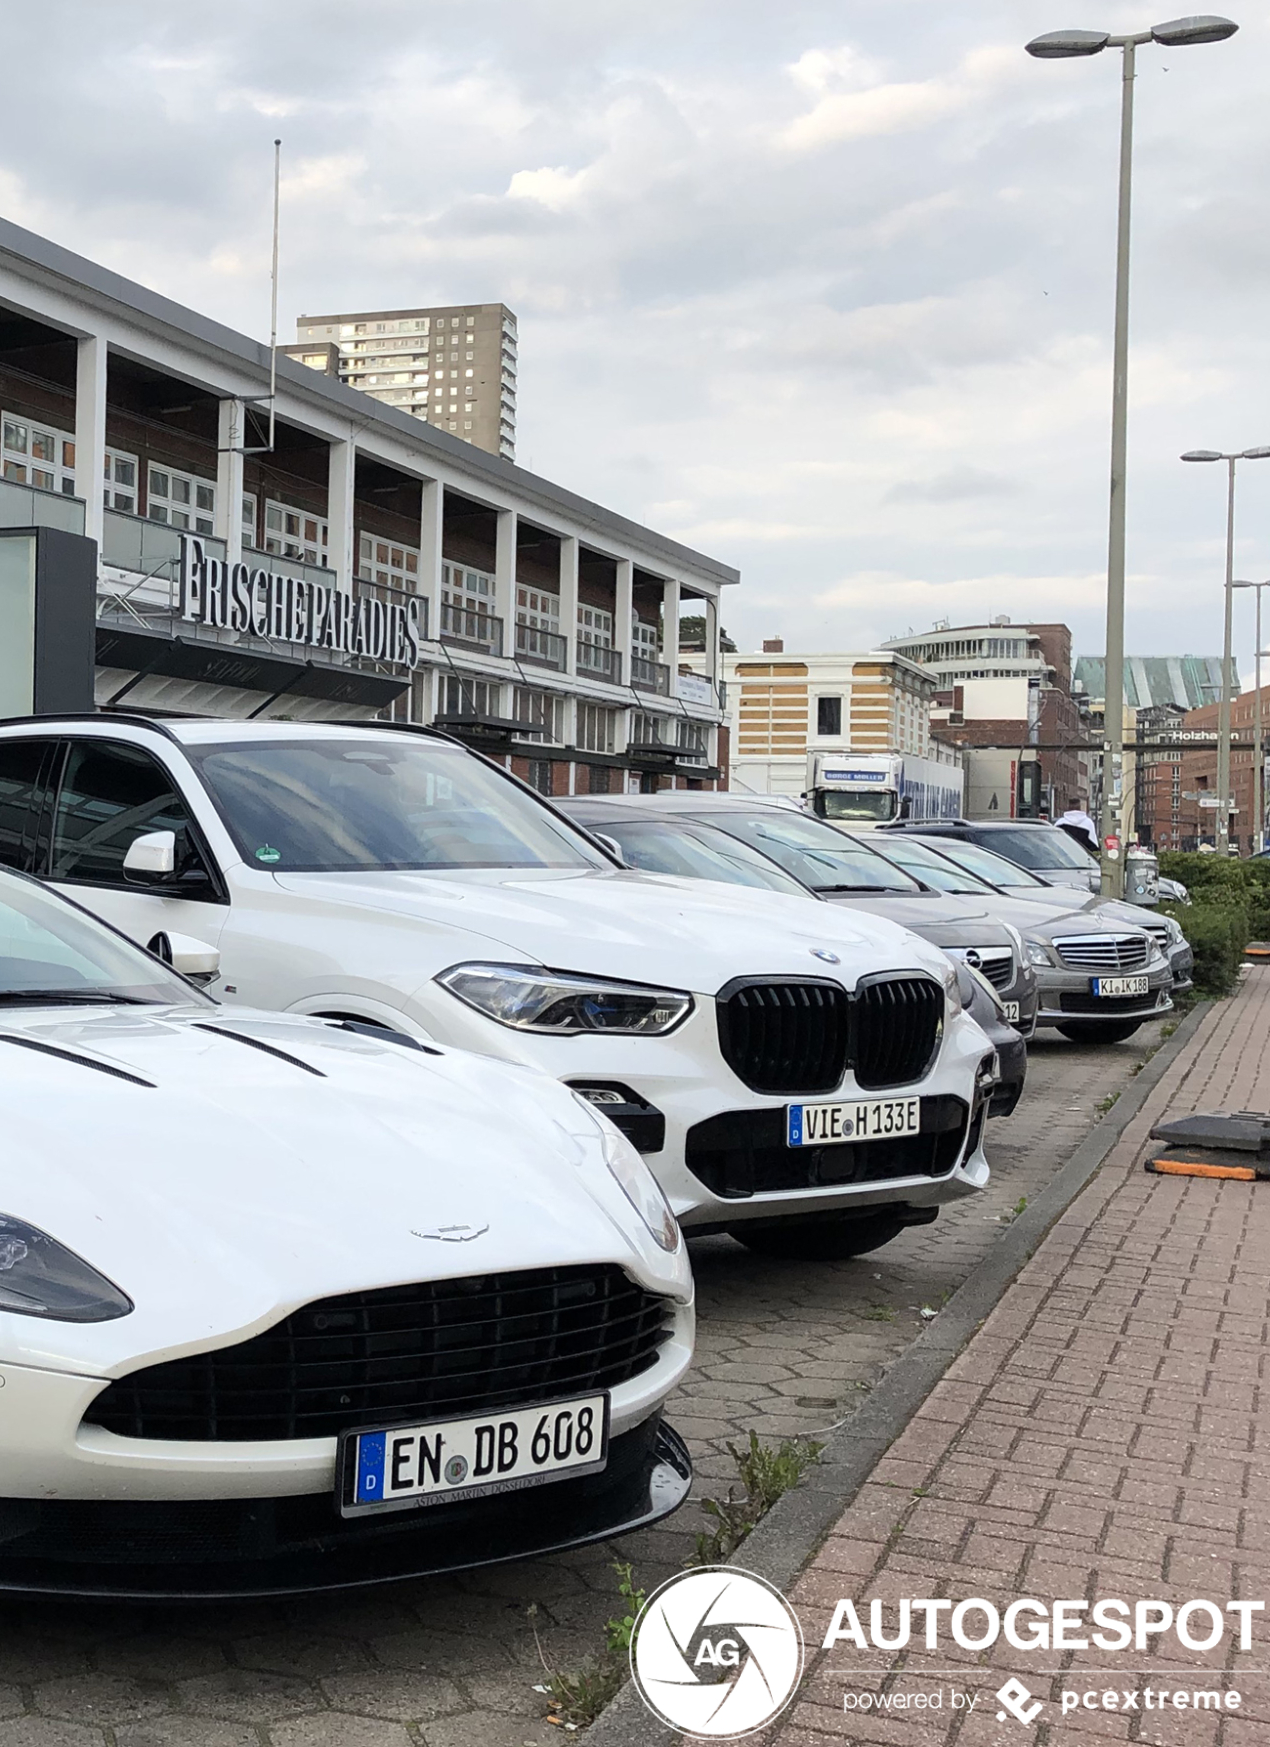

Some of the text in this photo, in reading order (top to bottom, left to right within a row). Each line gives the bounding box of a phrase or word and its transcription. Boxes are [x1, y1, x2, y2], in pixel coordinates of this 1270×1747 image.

[1101, 980, 1114, 993] KI
[792, 1101, 917, 1140] D VIE H 133E
[365, 1406, 593, 1491] D EN DB 608
[413, 1493, 447, 1508] ASTON
[450, 1486, 487, 1502] MARTIN
